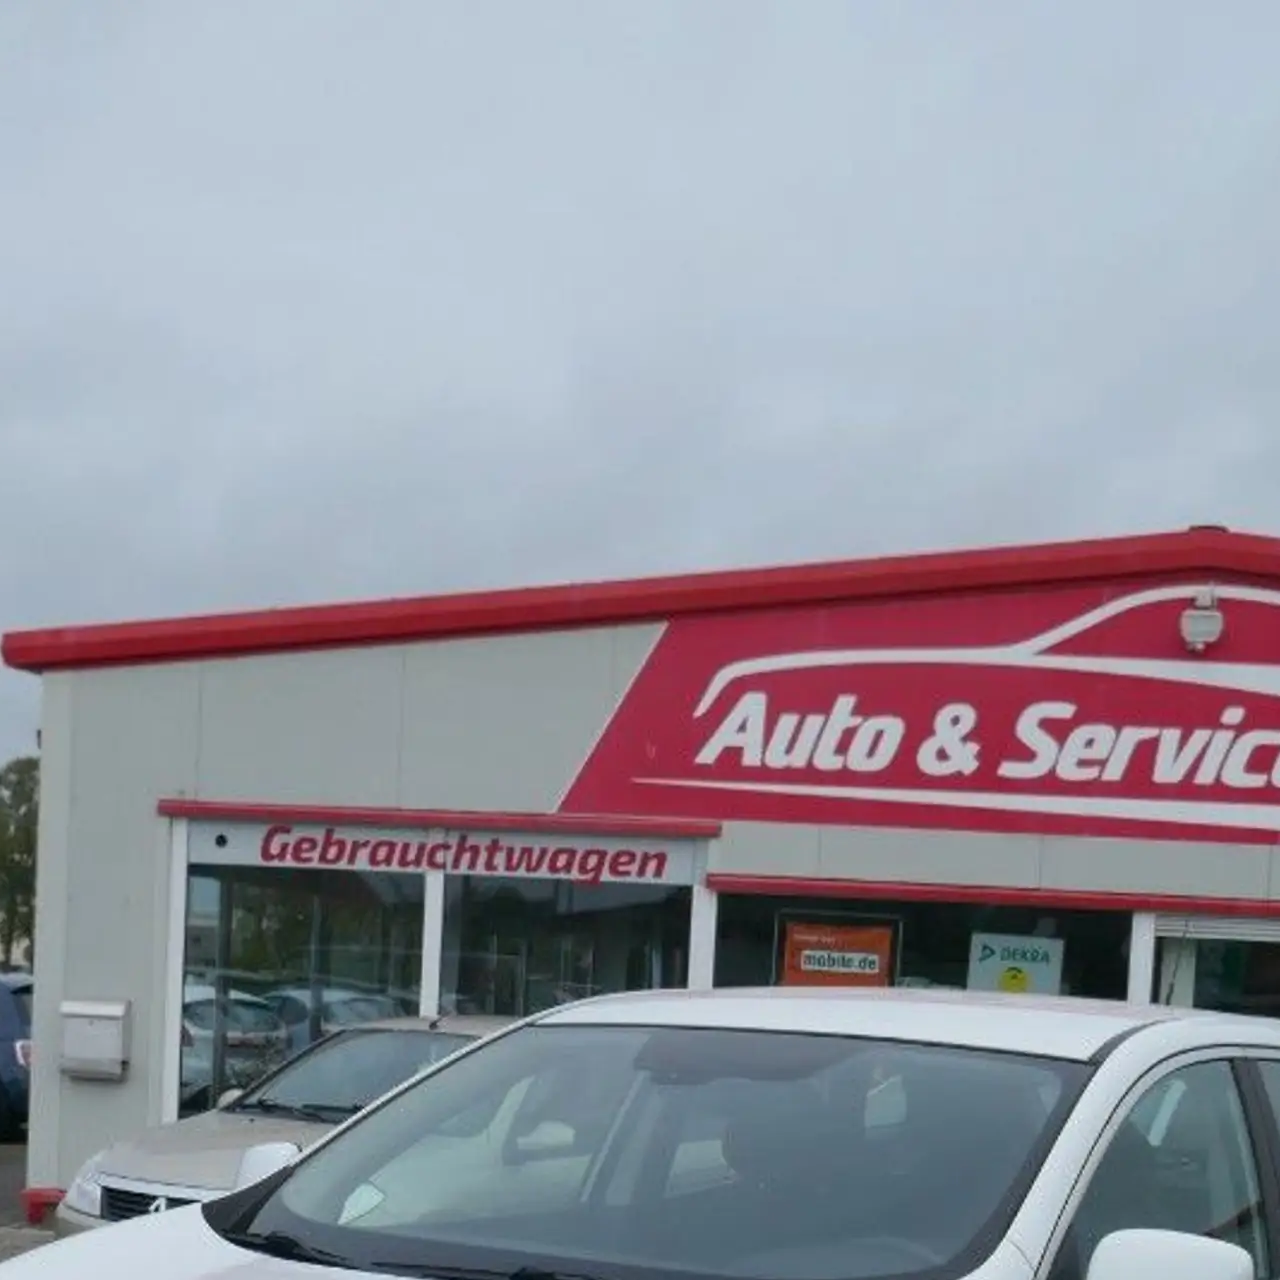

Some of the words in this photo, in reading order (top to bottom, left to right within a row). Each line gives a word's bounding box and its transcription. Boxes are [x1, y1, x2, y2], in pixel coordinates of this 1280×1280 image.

[695, 691, 905, 772] Auto
[916, 702, 980, 777] &
[260, 823, 669, 885] Gebrauchtwagen
[803, 951, 877, 971] mobile.de
[999, 944, 1051, 964] DEKRA
